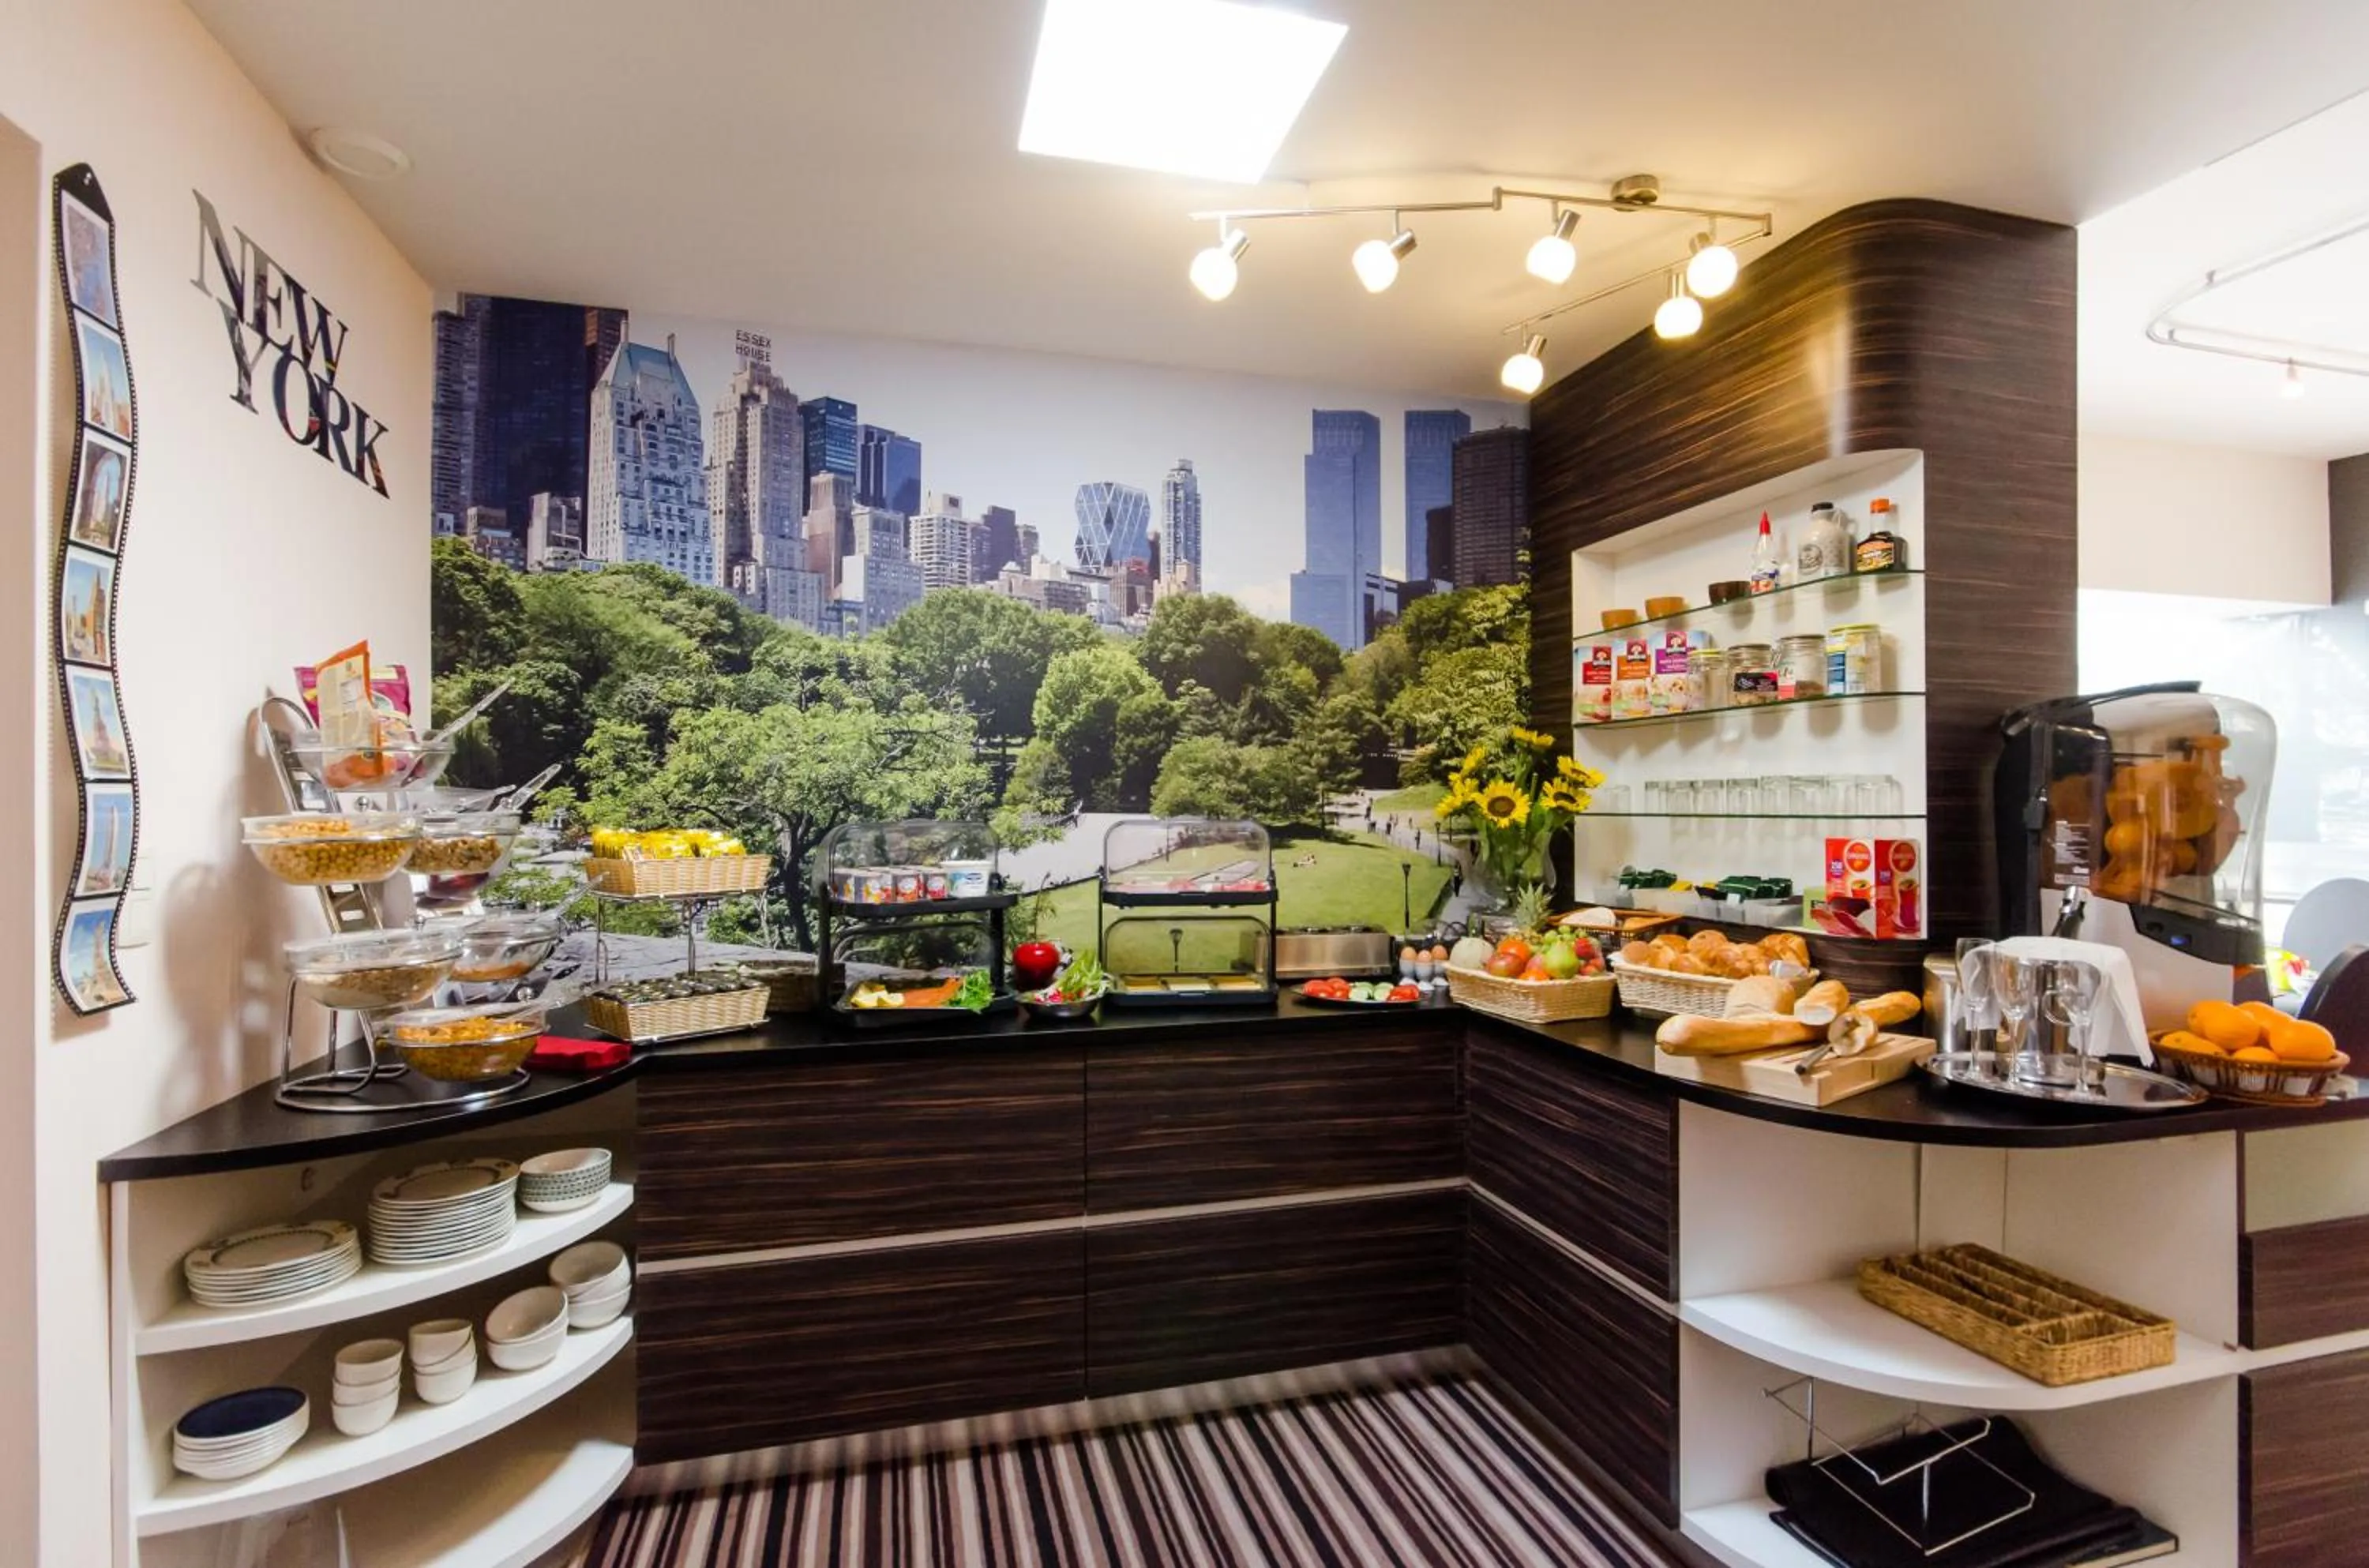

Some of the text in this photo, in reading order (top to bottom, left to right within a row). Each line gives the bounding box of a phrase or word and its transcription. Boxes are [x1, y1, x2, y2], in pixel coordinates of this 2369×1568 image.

[190, 189, 348, 386] NEW
[735, 329, 772, 349] ESSEX
[216, 298, 390, 500] YORK
[735, 343, 772, 362] HOUSE
